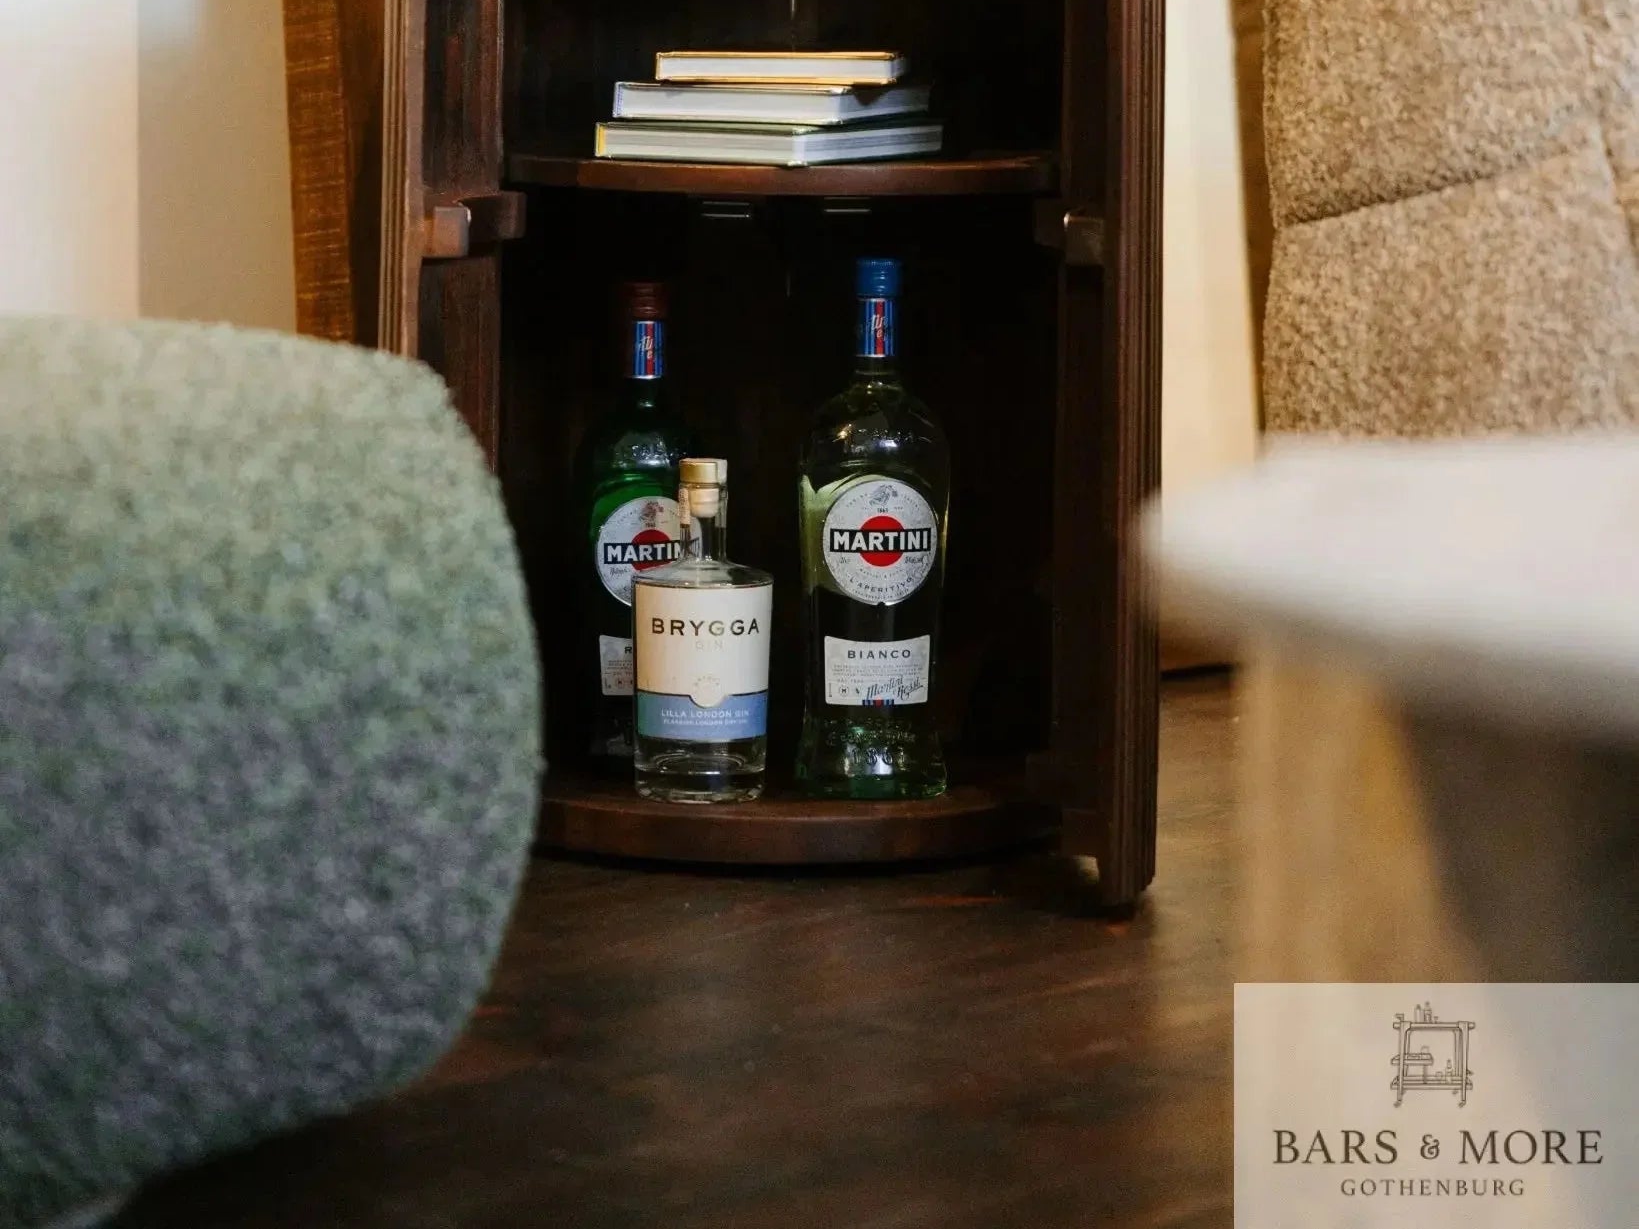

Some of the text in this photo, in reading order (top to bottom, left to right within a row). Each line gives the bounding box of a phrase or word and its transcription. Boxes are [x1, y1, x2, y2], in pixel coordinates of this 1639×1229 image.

[833, 530, 929, 551] MARTINI
[652, 617, 760, 637] BRYGGA
[695, 640, 724, 650] GIN
[847, 649, 912, 660] BIANCO
[661, 709, 687, 718] LILLA
[690, 709, 732, 718] LONDON
